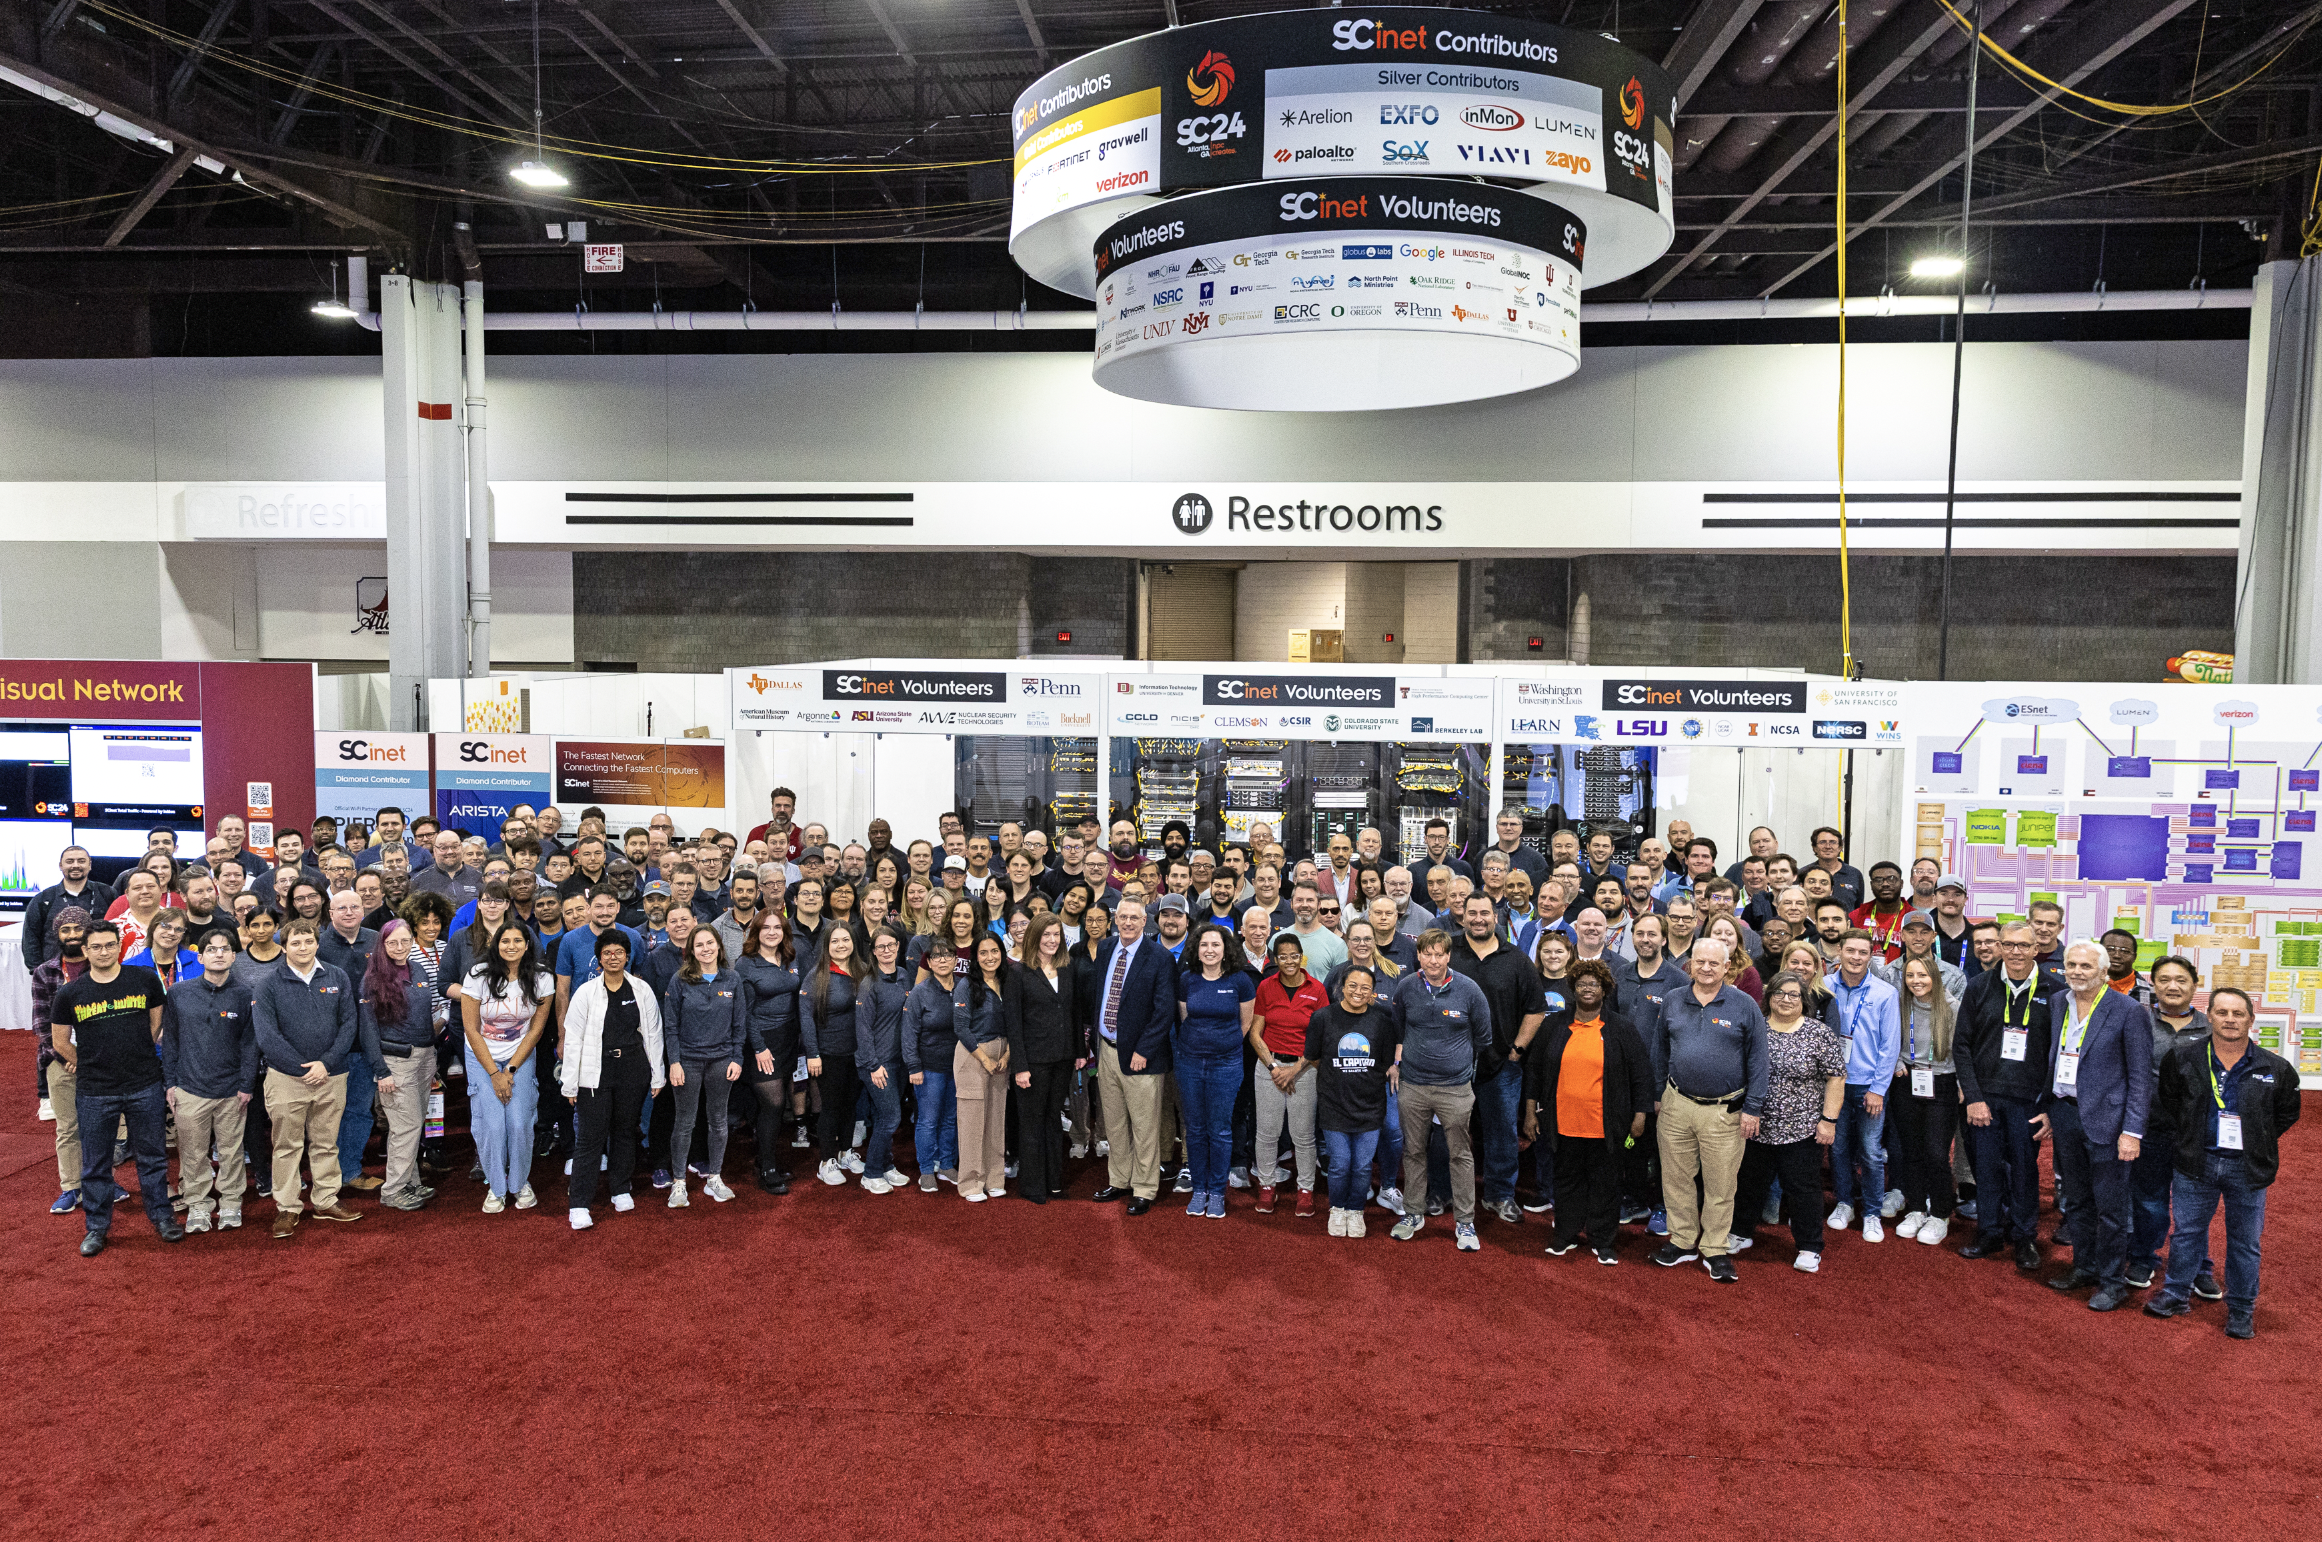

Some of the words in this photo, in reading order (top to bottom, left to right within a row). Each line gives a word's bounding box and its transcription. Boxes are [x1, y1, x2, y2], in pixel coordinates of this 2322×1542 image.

[1332, 19, 1427, 50] SCinet
[1436, 31, 1558, 64] Contributors
[1378, 70, 1422, 86] Silver
[1426, 71, 1520, 92] Contributors
[1040, 74, 1111, 118] Contributors
[1298, 109, 1353, 126] Arelion
[1380, 105, 1439, 125] EXFO
[1465, 106, 1515, 127] inMon
[1177, 111, 1246, 146] SC24
[1535, 116, 1595, 140] LUMEN
[1037, 120, 1084, 152] Contributors
[1099, 127, 1148, 161] gravwell
[1614, 131, 1649, 169] SC24
[1295, 145, 1355, 162] paloalto
[1457, 145, 1530, 165] VIAVI
[1545, 150, 1592, 174] zayo
[1096, 169, 1149, 192] verizon
[1280, 191, 1367, 221] SCinet
[1379, 194, 1501, 227] Volunteers
[1111, 220, 1185, 261] Volunteers
[591, 246, 616, 256] FIRE
[1253, 250, 1278, 260] Georgia
[1343, 246, 1366, 258] globus
[1377, 247, 1392, 256] labs
[1400, 243, 1445, 262] Google
[1452, 248, 1479, 259] ILLINOIS
[1480, 251, 1495, 261] TECH
[1254, 258, 1270, 266] Tech
[1363, 275, 1382, 283] North
[1382, 275, 1399, 283] Point
[1363, 281, 1394, 289] Ministries
[1417, 275, 1433, 285] OAK
[1434, 276, 1456, 285] RIDGE
[1153, 288, 1183, 307] NSRC
[1199, 299, 1214, 308] NYU
[1288, 303, 1320, 319] CRC
[1350, 308, 1382, 316] OREGON
[1409, 302, 1442, 318] Penn
[1466, 310, 1489, 321] DALLAS
[1143, 320, 1177, 341] UNLV
[1228, 495, 1443, 531] Restrooms
[74, 678, 184, 702] Network
[768, 681, 803, 690] DALLAS
[836, 675, 895, 694] SCinet
[901, 679, 994, 696] Volunteers
[1041, 678, 1081, 695] Penn
[1217, 680, 1278, 699] SCinet
[1285, 684, 1382, 701] Volunteers
[1530, 683, 1582, 697] Washington
[1519, 697, 1550, 705] University
[1617, 685, 1682, 704] SCinet
[1689, 689, 1793, 706] Volunteers
[1834, 690, 1885, 698] UNIVERSITY
[1887, 690, 1898, 698] OF
[1852, 699, 1898, 707] FRANCISCO
[2021, 704, 2049, 714] ESnet
[740, 708, 765, 716] American
[766, 708, 790, 716] Museum
[797, 711, 830, 722] Argonne
[851, 710, 875, 722] ASU
[1060, 712, 1091, 724] Bucknell
[1125, 713, 1159, 721] CCLD
[2219, 710, 2254, 718] verizon
[1289, 716, 1311, 725] CSIR
[1511, 719, 1560, 732] LEARN
[1616, 720, 1668, 736] LSU
[1770, 725, 1800, 735] NCSA
[1876, 732, 1901, 740] WINS
[339, 740, 406, 762] SCinet
[460, 742, 527, 764] SCinet
[564, 751, 579, 760] The
[580, 751, 609, 761] Fastest
[611, 752, 645, 762] Network
[564, 762, 608, 773] Connecting
[610, 763, 623, 773] the
[625, 764, 653, 773] Fastest
[655, 765, 699, 775] Computers
[335, 775, 369, 783] Diamond
[370, 775, 411, 784] Contributor
[456, 777, 489, 785] Diamond
[491, 777, 532, 786] Contributor
[564, 778, 590, 788] SCinet
[449, 804, 508, 818] ARISTA
[1332, 1057, 1342, 1067] EL
